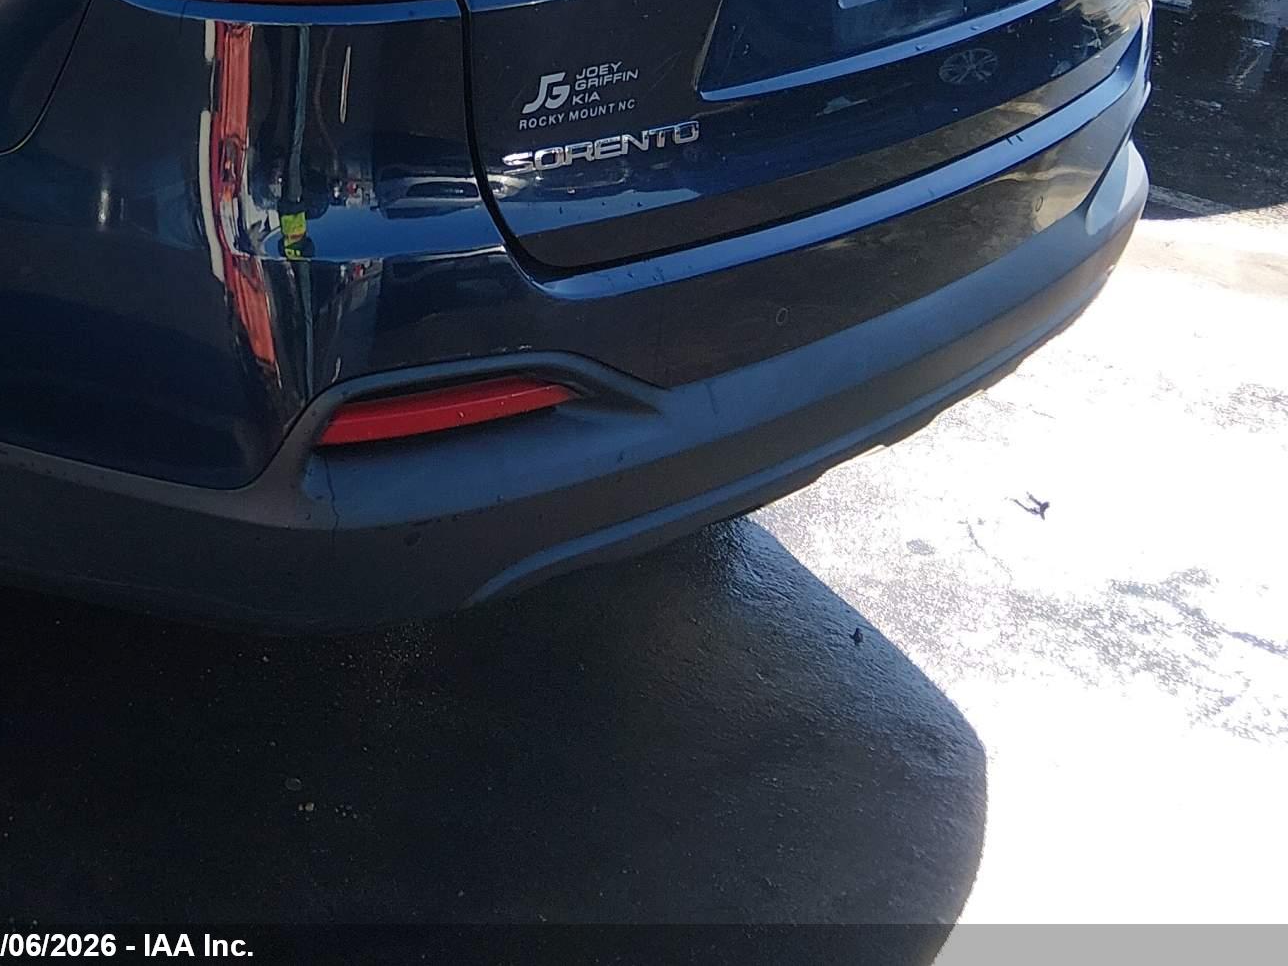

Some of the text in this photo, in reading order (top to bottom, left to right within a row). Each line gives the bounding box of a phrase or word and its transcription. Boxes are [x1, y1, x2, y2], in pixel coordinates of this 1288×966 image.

[574, 68, 639, 91] GRIFFIN
[576, 61, 623, 80] JOEY
[572, 91, 600, 106] KIA
[519, 99, 636, 131] ROCKY MOUNT NC
[502, 121, 700, 175] SORENTO
